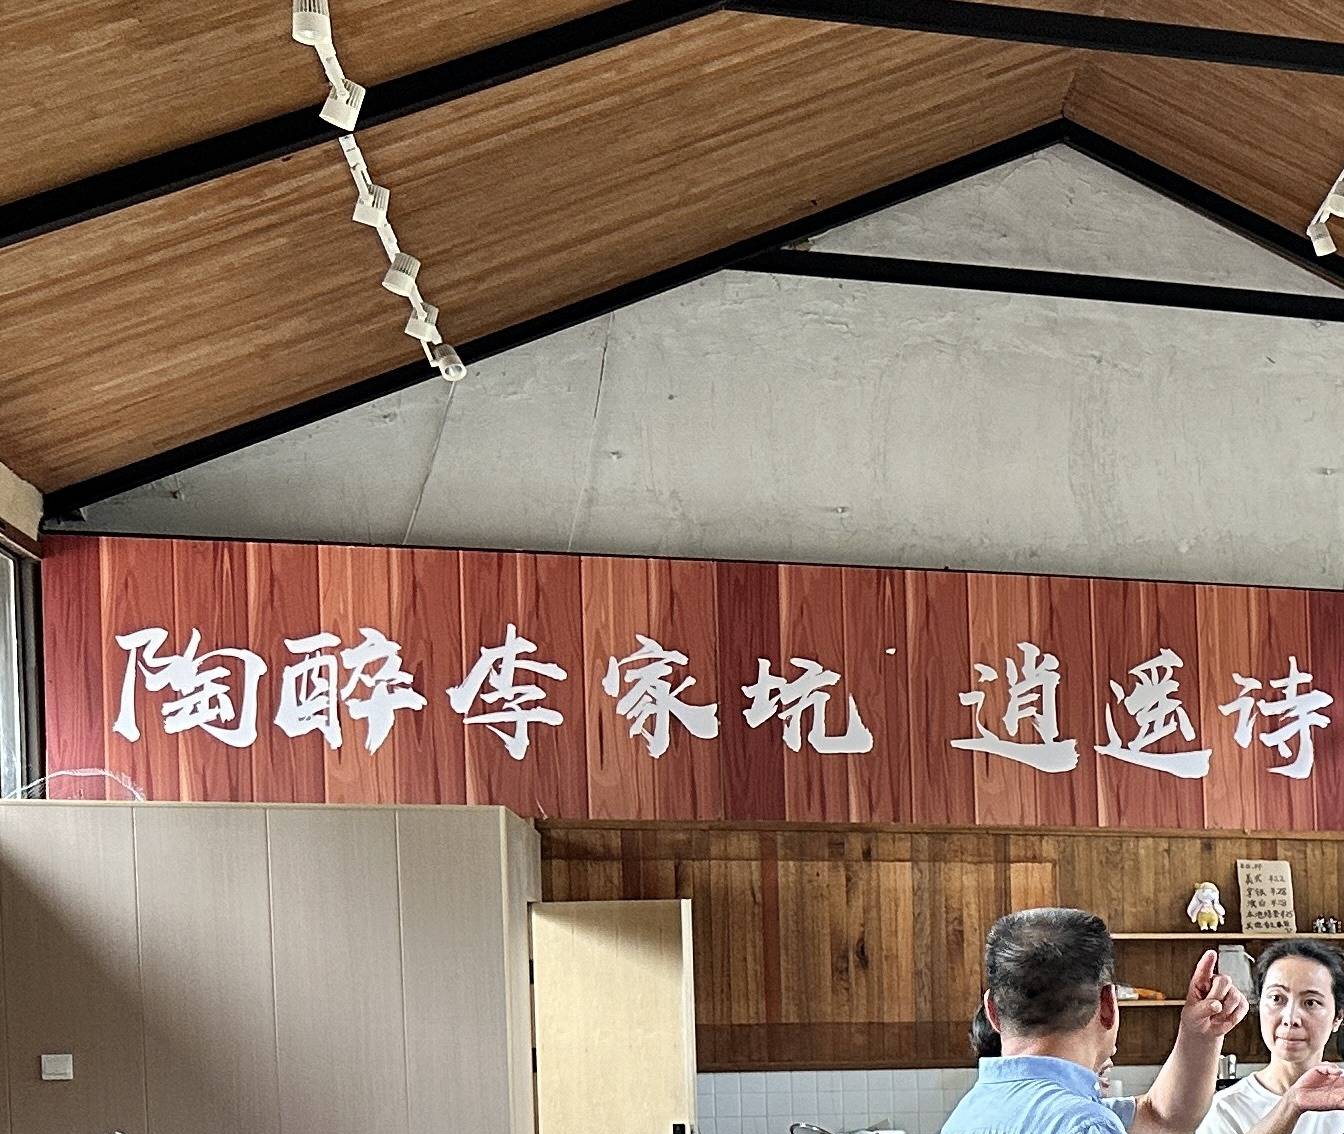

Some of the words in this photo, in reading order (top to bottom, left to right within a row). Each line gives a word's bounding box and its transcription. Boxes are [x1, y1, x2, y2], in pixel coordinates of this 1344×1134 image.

[112, 623, 874, 760] 陶醉李家坑
